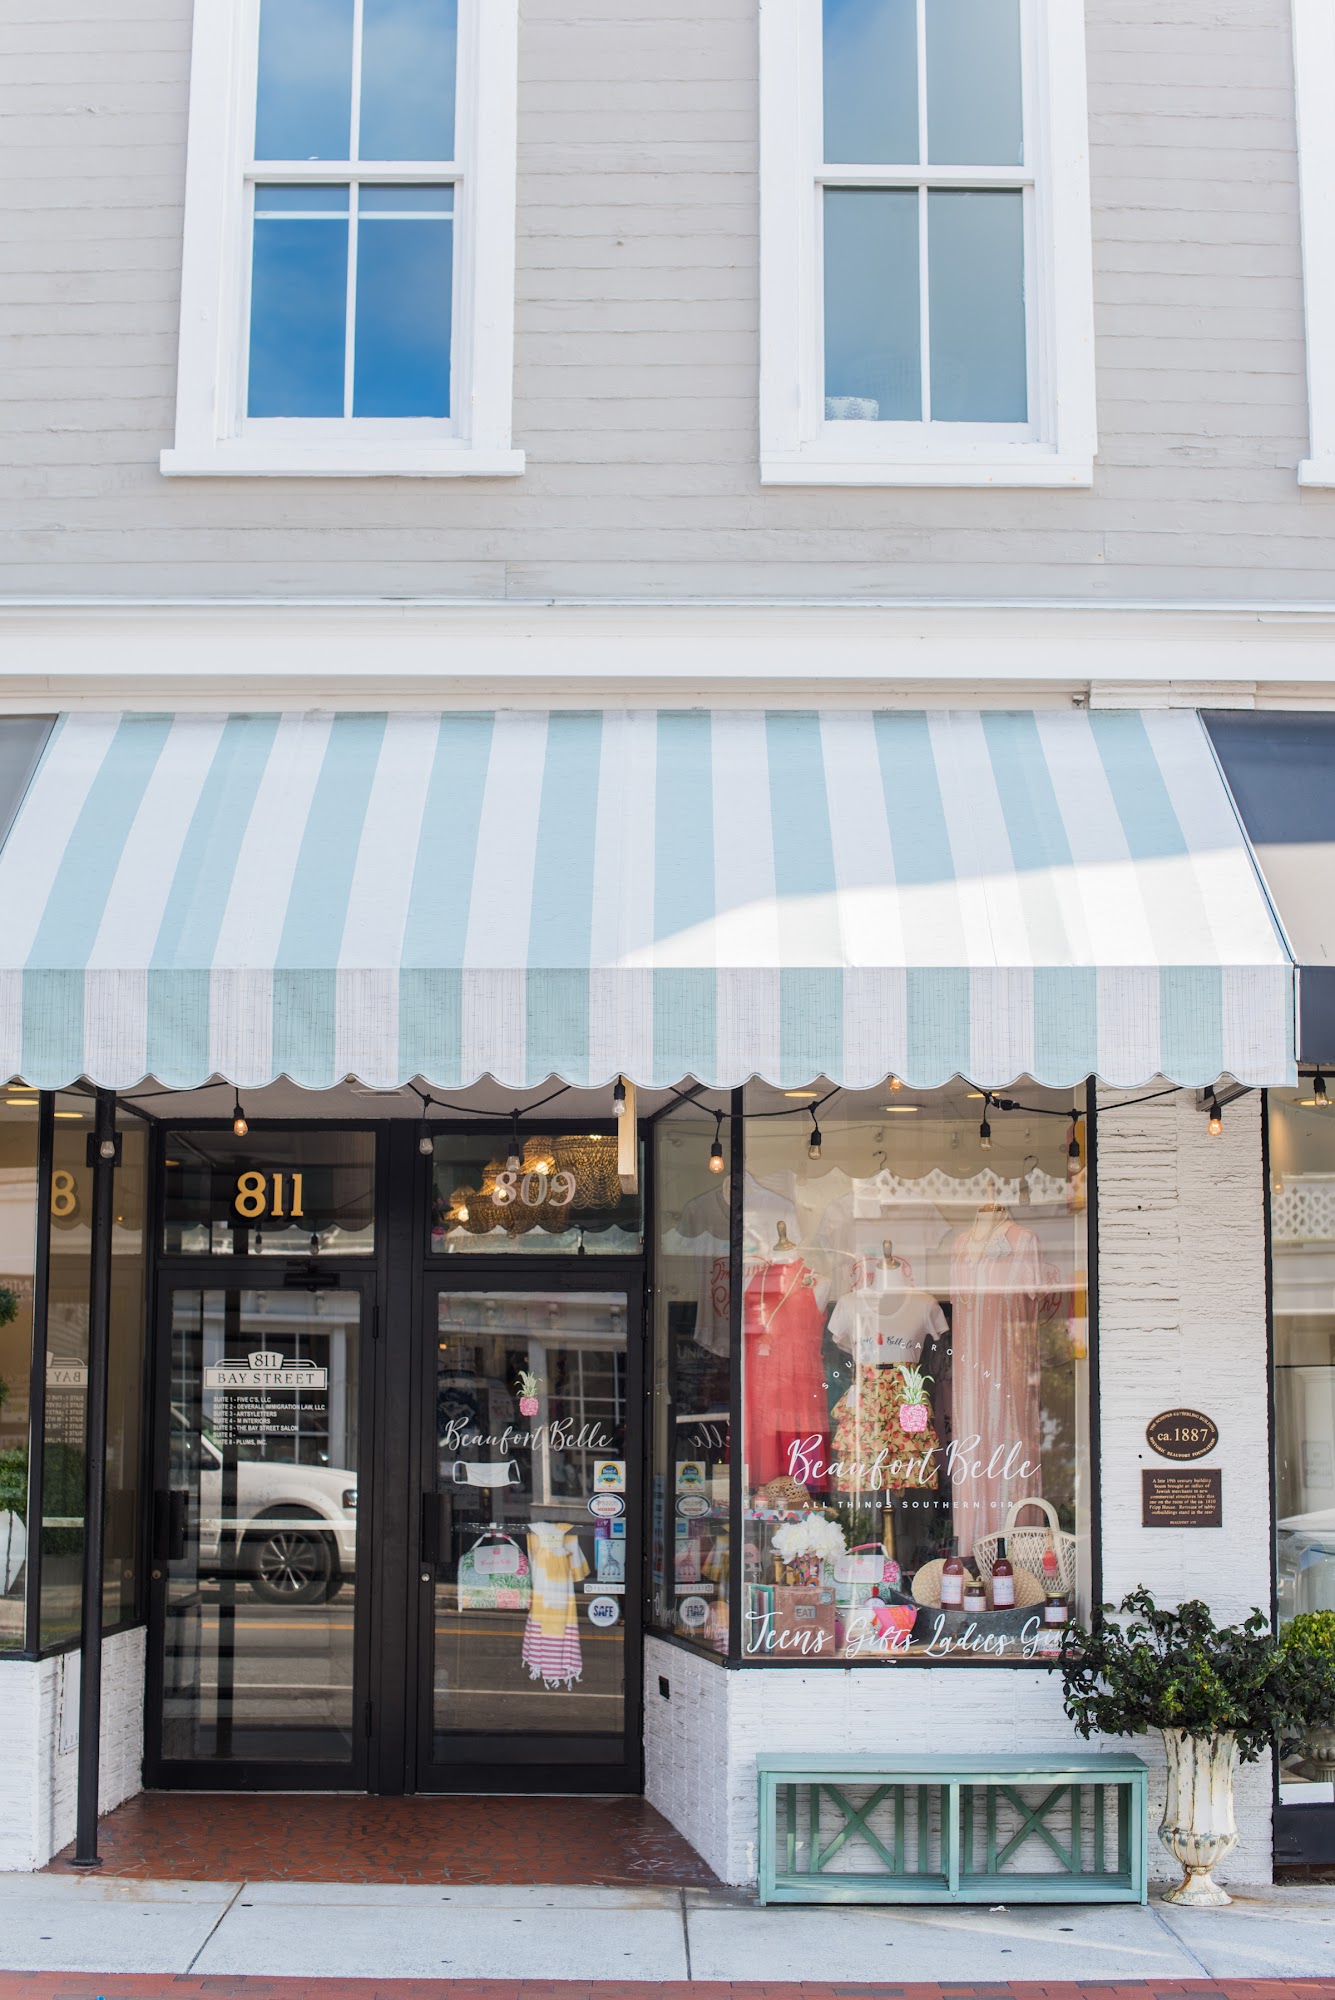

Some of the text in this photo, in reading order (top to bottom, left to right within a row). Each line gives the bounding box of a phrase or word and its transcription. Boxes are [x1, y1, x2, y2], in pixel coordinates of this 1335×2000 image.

[235, 1171, 304, 1218] 811
[492, 1172, 576, 1207] 809
[254, 1354, 277, 1367] 811
[900, 1342, 1002, 1390] CAROLINA
[218, 1373, 315, 1384] BAY STREET
[445, 1417, 613, 1454] Beaufort Belle
[1157, 1428, 1208, 1442] ca. 1887
[787, 1434, 1041, 1490] Beaufort Belle
[593, 1605, 613, 1617] SAFE
[796, 1608, 814, 1617] EAT
[745, 1611, 833, 1655] Teens
[845, 1616, 920, 1659] Gifts
[923, 1613, 1014, 1657] Ladies
